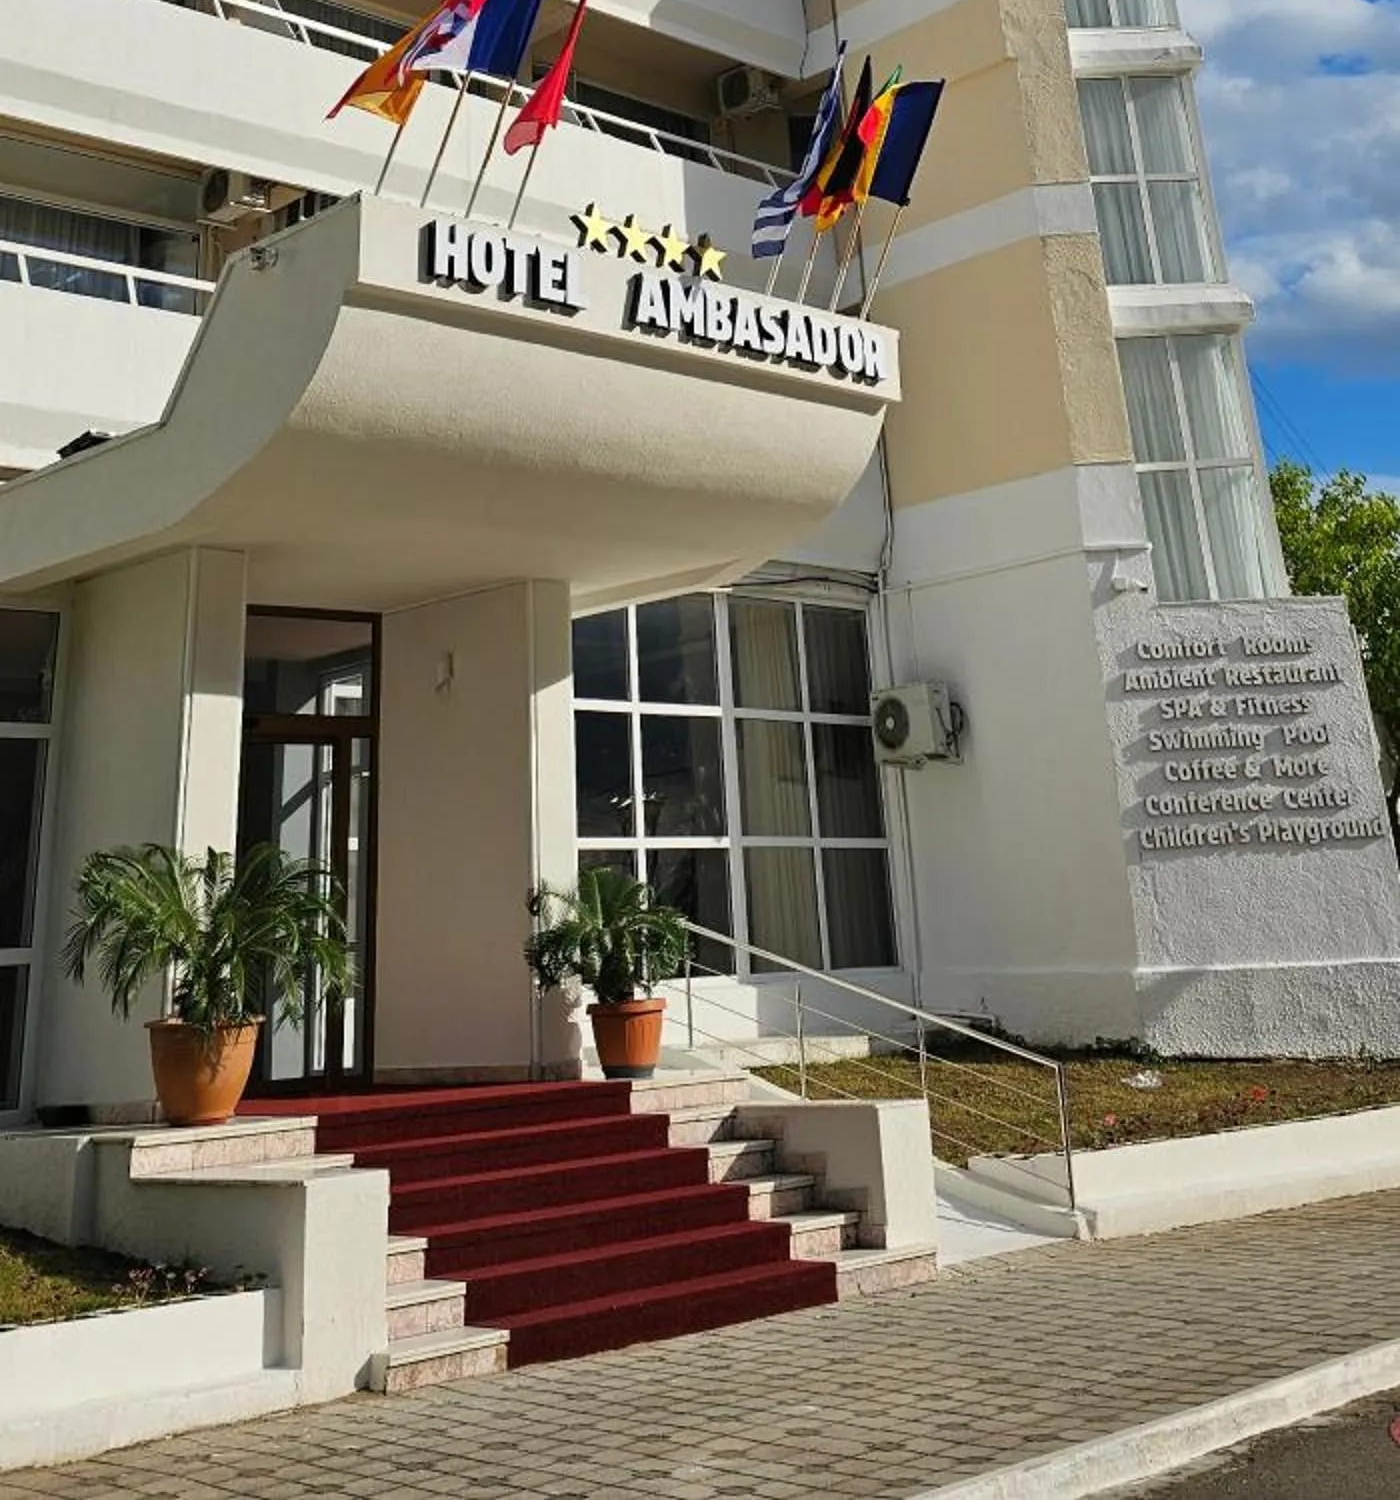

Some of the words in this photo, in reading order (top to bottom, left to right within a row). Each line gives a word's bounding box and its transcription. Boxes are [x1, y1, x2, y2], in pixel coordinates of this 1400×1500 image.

[429, 217, 586, 310] HOTEL
[631, 271, 887, 381] AMBASADOR
[1136, 637, 1228, 659] Comfort
[1242, 636, 1313, 656] Rooms
[1124, 668, 1216, 692] Ambient
[1224, 663, 1341, 686] Restaurant
[1160, 698, 1203, 719] SPA
[1209, 697, 1228, 717] &
[1235, 696, 1313, 716] Fitness
[1150, 728, 1266, 751] Swimming
[1282, 724, 1331, 745] Pool
[1164, 759, 1237, 782] Coffee
[1243, 757, 1262, 779] &
[1272, 755, 1329, 778] More
[1145, 792, 1273, 816] Conference
[1282, 788, 1351, 809] Center
[1140, 821, 1251, 849] Children's
[1258, 817, 1387, 844] Playground
